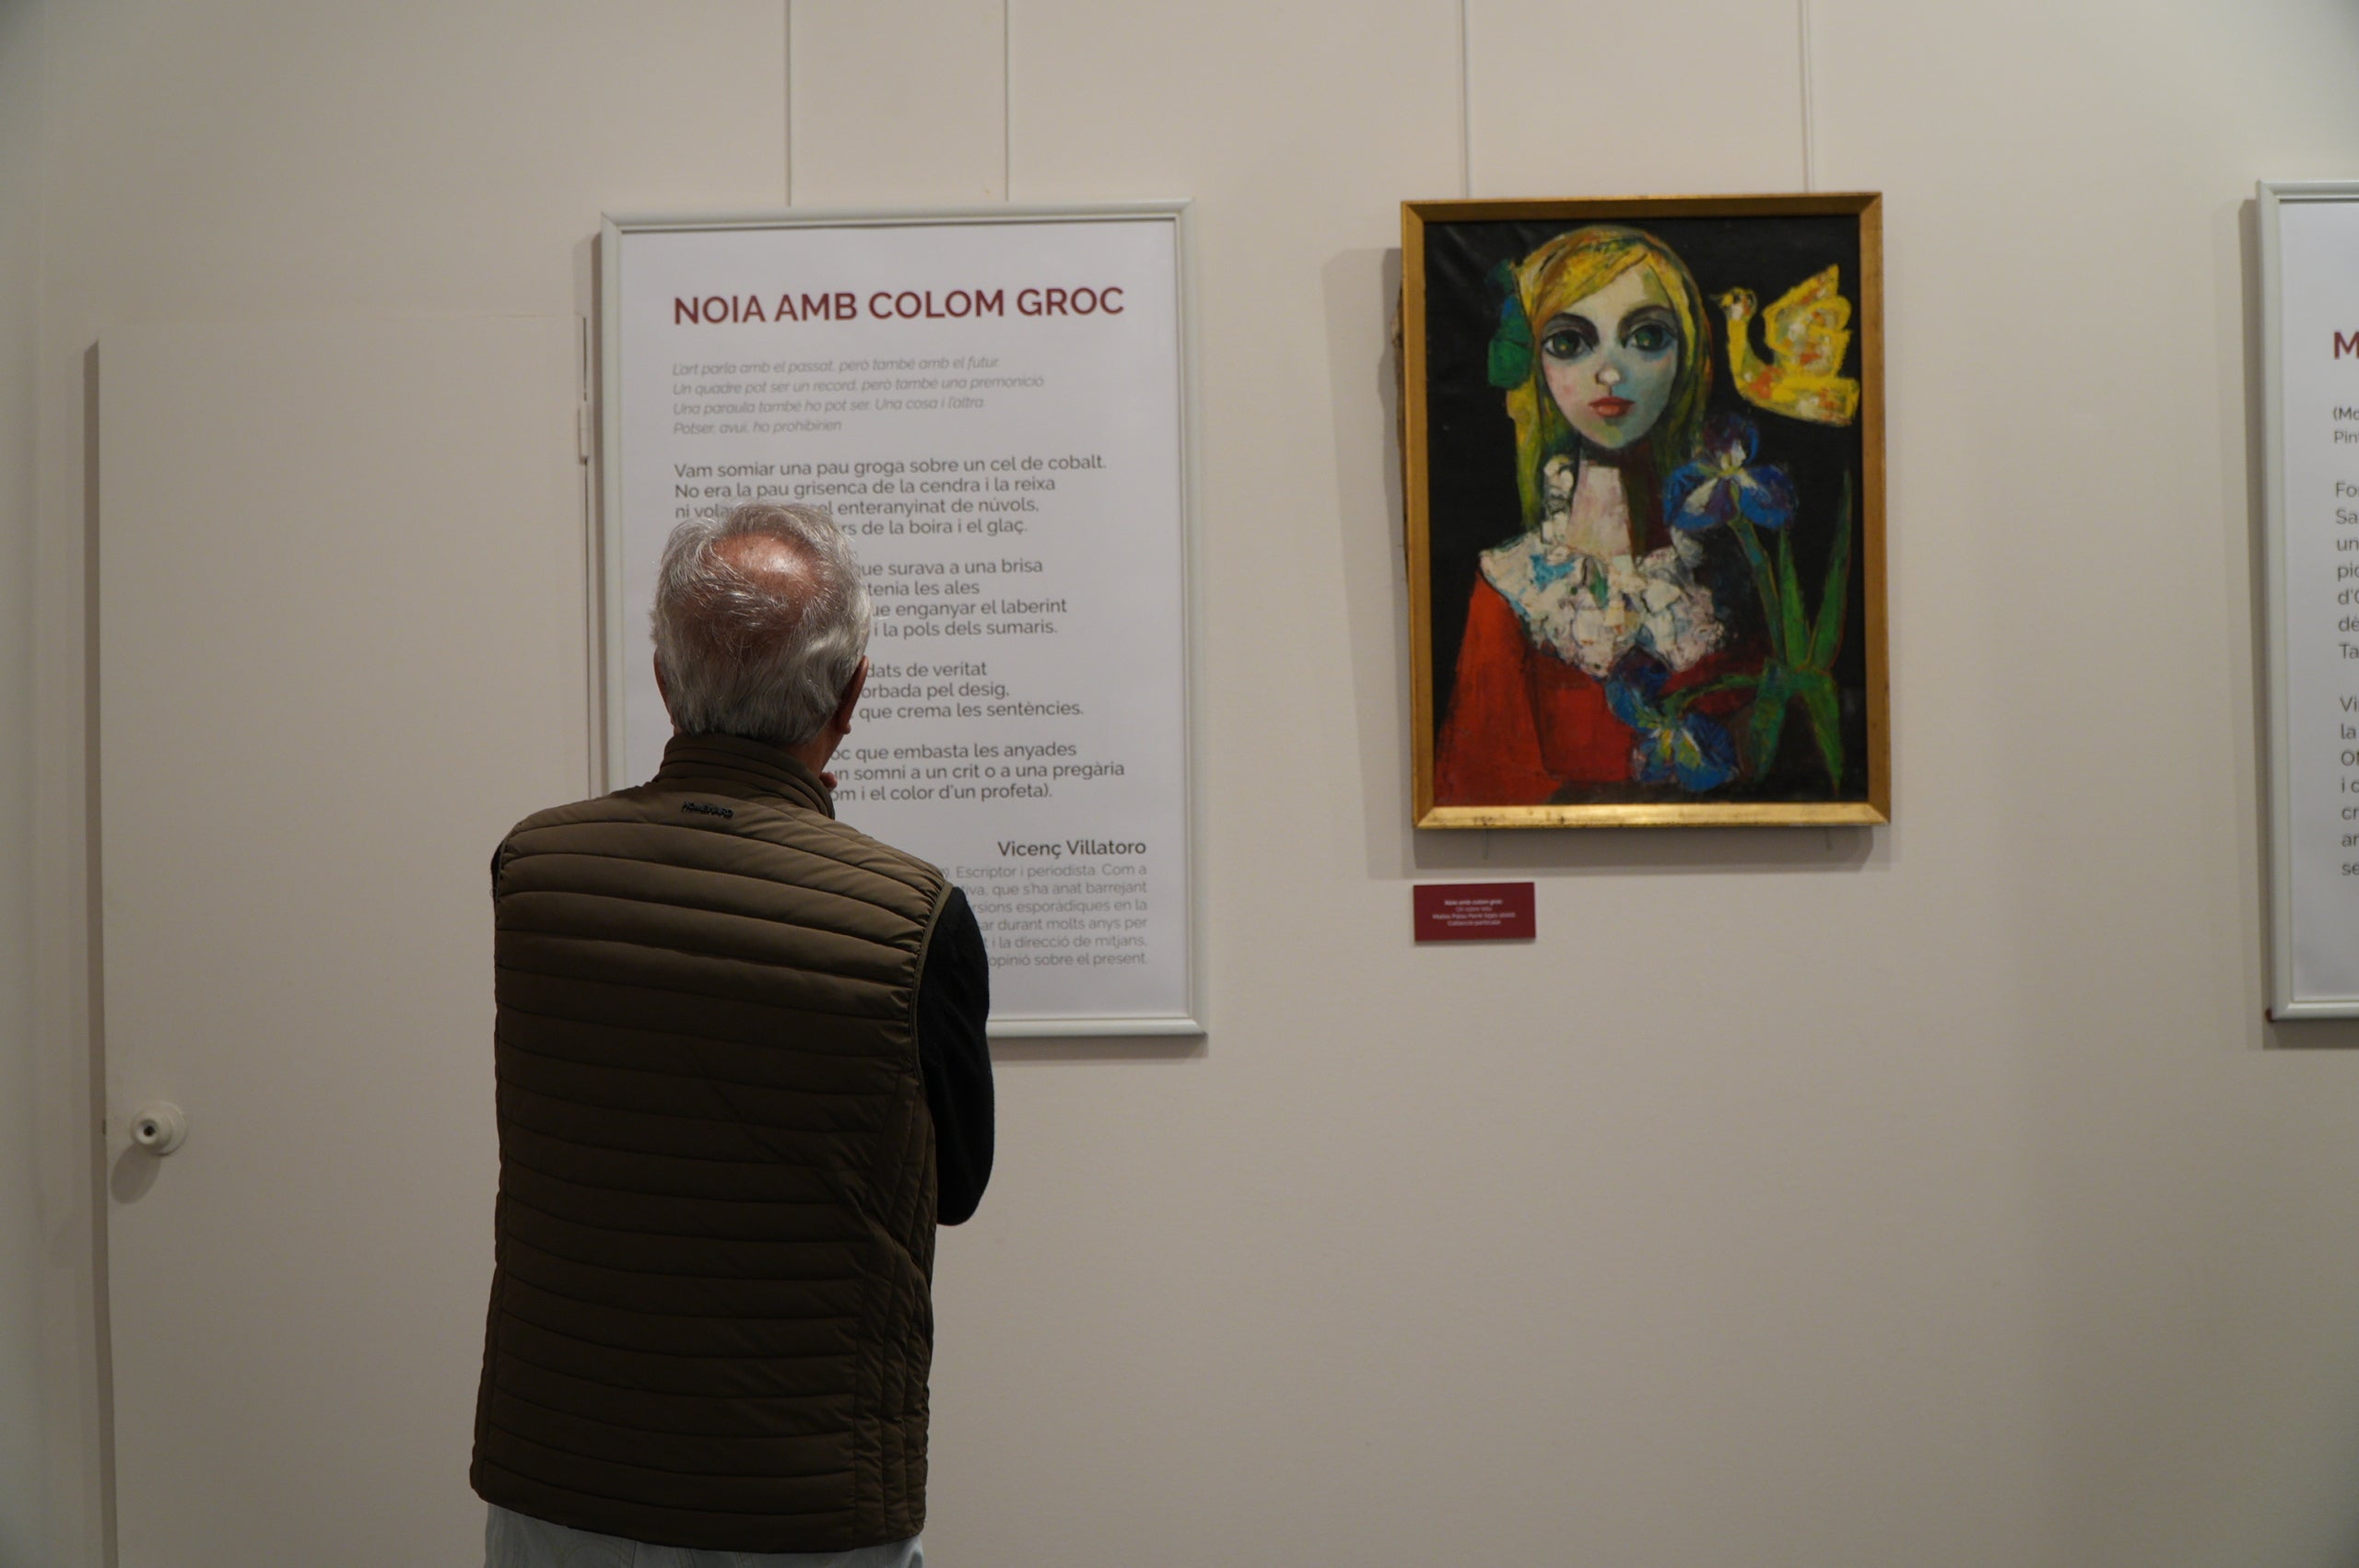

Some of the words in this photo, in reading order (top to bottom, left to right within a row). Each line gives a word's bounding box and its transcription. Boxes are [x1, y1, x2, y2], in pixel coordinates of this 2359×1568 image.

[675, 295, 766, 324] NOIA
[775, 292, 858, 322] AMB
[868, 289, 1003, 320] COLOM
[1016, 286, 1123, 316] GROC
[2333, 330, 2359, 359] M
[700, 361, 736, 380] parla
[739, 360, 770, 375] amb
[772, 360, 785, 374] el
[838, 359, 869, 376] però
[871, 357, 915, 371] també
[917, 356, 949, 370] amb
[952, 356, 965, 369] el
[672, 381, 692, 395] Un
[694, 380, 742, 399] quadre
[744, 381, 767, 397] pot
[769, 383, 790, 393] ser
[792, 382, 810, 392] un
[861, 379, 892, 395] però
[894, 377, 938, 391] també
[940, 380, 968, 390] una
[672, 401, 701, 415] Una
[703, 400, 756, 417] paraula
[757, 399, 802, 413] també
[804, 398, 822, 412] ho
[824, 399, 847, 415] pot
[874, 396, 903, 410] Una
[905, 399, 938, 410] cosa
[939, 396, 945, 409] i
[753, 419, 769, 433] ho
[675, 462, 712, 478] Vam
[717, 461, 775, 477] somiar
[780, 463, 812, 476] una
[816, 462, 850, 480] pau
[854, 462, 905, 479] groga
[910, 456, 959, 474] sobre
[964, 460, 985, 473] un
[990, 455, 1016, 472] cel
[1021, 454, 1043, 471] de
[1048, 453, 1106, 471] cobalt.
[675, 482, 699, 498] No
[704, 486, 732, 497] era
[736, 481, 752, 497] la
[757, 484, 789, 501] pau
[872, 477, 895, 494] de
[899, 477, 915, 494] la
[920, 476, 980, 493] cendra
[984, 476, 990, 492] i
[994, 475, 1010, 492] la
[1015, 475, 1055, 491] reixa
[675, 503, 689, 519] ni
[838, 498, 945, 520] enteranyinat
[951, 497, 974, 513] de
[861, 519, 885, 535] de
[889, 518, 904, 534] la
[909, 518, 953, 534] boira
[957, 518, 963, 533] i
[967, 517, 983, 533] el
[861, 564, 884, 576] ue
[888, 563, 945, 576] surava
[949, 562, 959, 575] a
[964, 562, 997, 574] una
[1002, 556, 1043, 574] brisa
[867, 580, 910, 596] tenia
[915, 579, 939, 595] les
[945, 578, 980, 595] ales
[895, 603, 977, 621] enganyar
[980, 599, 997, 614] el
[1001, 597, 1067, 614] laberint
[874, 622, 879, 638] i
[883, 621, 898, 637] la
[903, 620, 940, 641] pols
[945, 619, 981, 636] dels
[986, 618, 1057, 635] sumaris.
[867, 661, 902, 678] dats
[906, 661, 929, 677] de
[933, 661, 988, 677] veritat
[861, 682, 922, 699] orbada
[926, 681, 955, 702] pel
[858, 707, 893, 724] que
[897, 706, 952, 719] crema
[957, 700, 982, 718] les
[986, 699, 1084, 717] sentències.
[855, 747, 888, 764] que
[894, 742, 968, 759] embasta
[974, 741, 999, 757] les
[1004, 740, 1076, 762] anyades
[854, 765, 906, 780] somni
[910, 767, 921, 779] a
[926, 766, 947, 779] un
[952, 763, 980, 778] crit
[984, 766, 996, 778] o
[1001, 766, 1011, 778] a
[1015, 765, 1048, 778] una
[1053, 760, 1124, 781] pregària
[861, 786, 865, 801] i
[871, 784, 885, 801] el
[891, 784, 933, 801] color
[939, 783, 975, 800] d'un
[981, 781, 1051, 803] profeta).
[997, 840, 1062, 860] Vicenç
[1066, 838, 1147, 856] Villatoro
[956, 863, 1017, 881] Escriptor
[1019, 864, 1025, 876] i
[1101, 861, 1135, 875] Com
[1138, 865, 1147, 875] a
[992, 885, 1019, 899] que
[1052, 882, 1082, 895] anat
[1086, 880, 1147, 897] barrejant
[1114, 901, 1132, 911] en
[1135, 897, 1147, 911] la
[997, 917, 1042, 930] durant
[1047, 916, 1085, 930] molts
[1088, 919, 1121, 933] anys
[1124, 919, 1147, 932] per
[991, 936, 997, 949] i
[999, 935, 1012, 949] la
[1015, 934, 1070, 949] direcció
[1073, 934, 1092, 948] de
[1035, 952, 1074, 965] sobre
[1077, 952, 1089, 965] el
